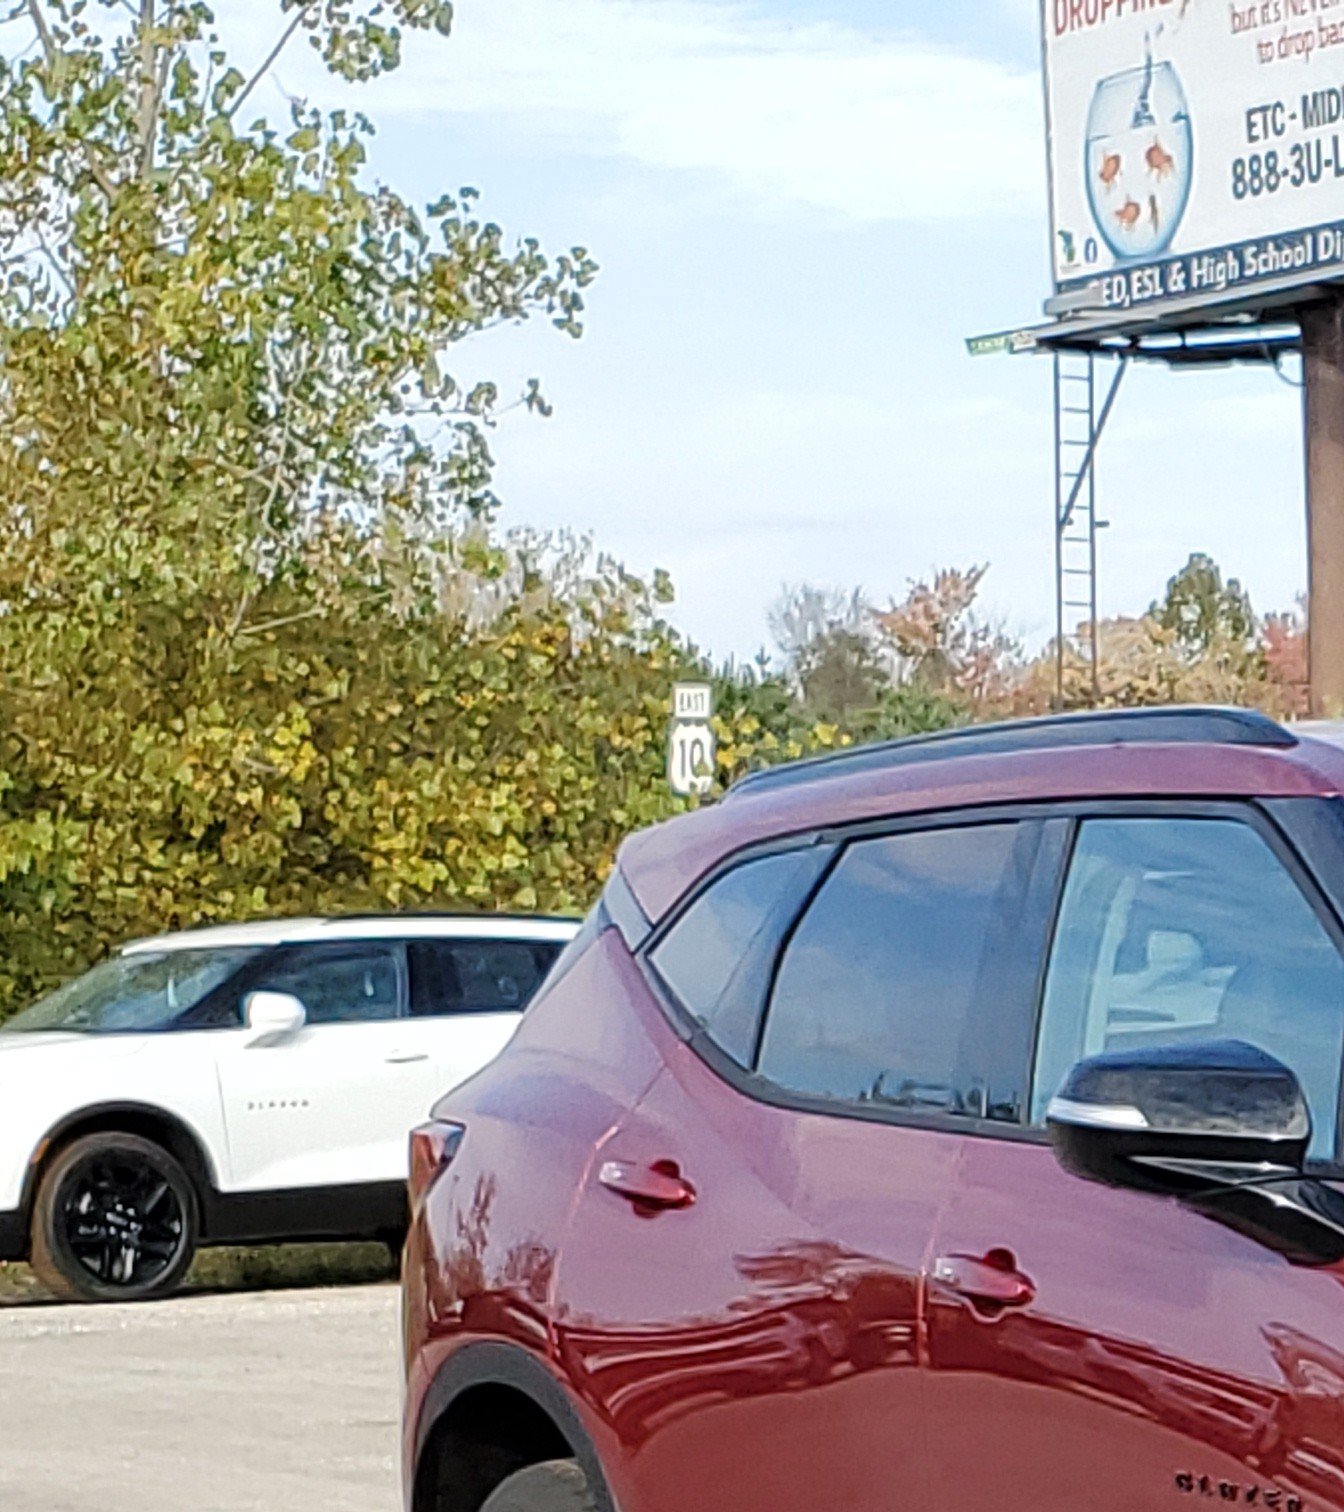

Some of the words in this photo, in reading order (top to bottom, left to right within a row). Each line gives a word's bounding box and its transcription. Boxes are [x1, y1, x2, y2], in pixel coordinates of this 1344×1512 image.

[1257, 41, 1274, 64] to
[1277, 26, 1315, 64] drop
[1168, 261, 1186, 293] &
[1190, 250, 1240, 291] High
[1243, 232, 1313, 277] School
[680, 738, 705, 779] 10
